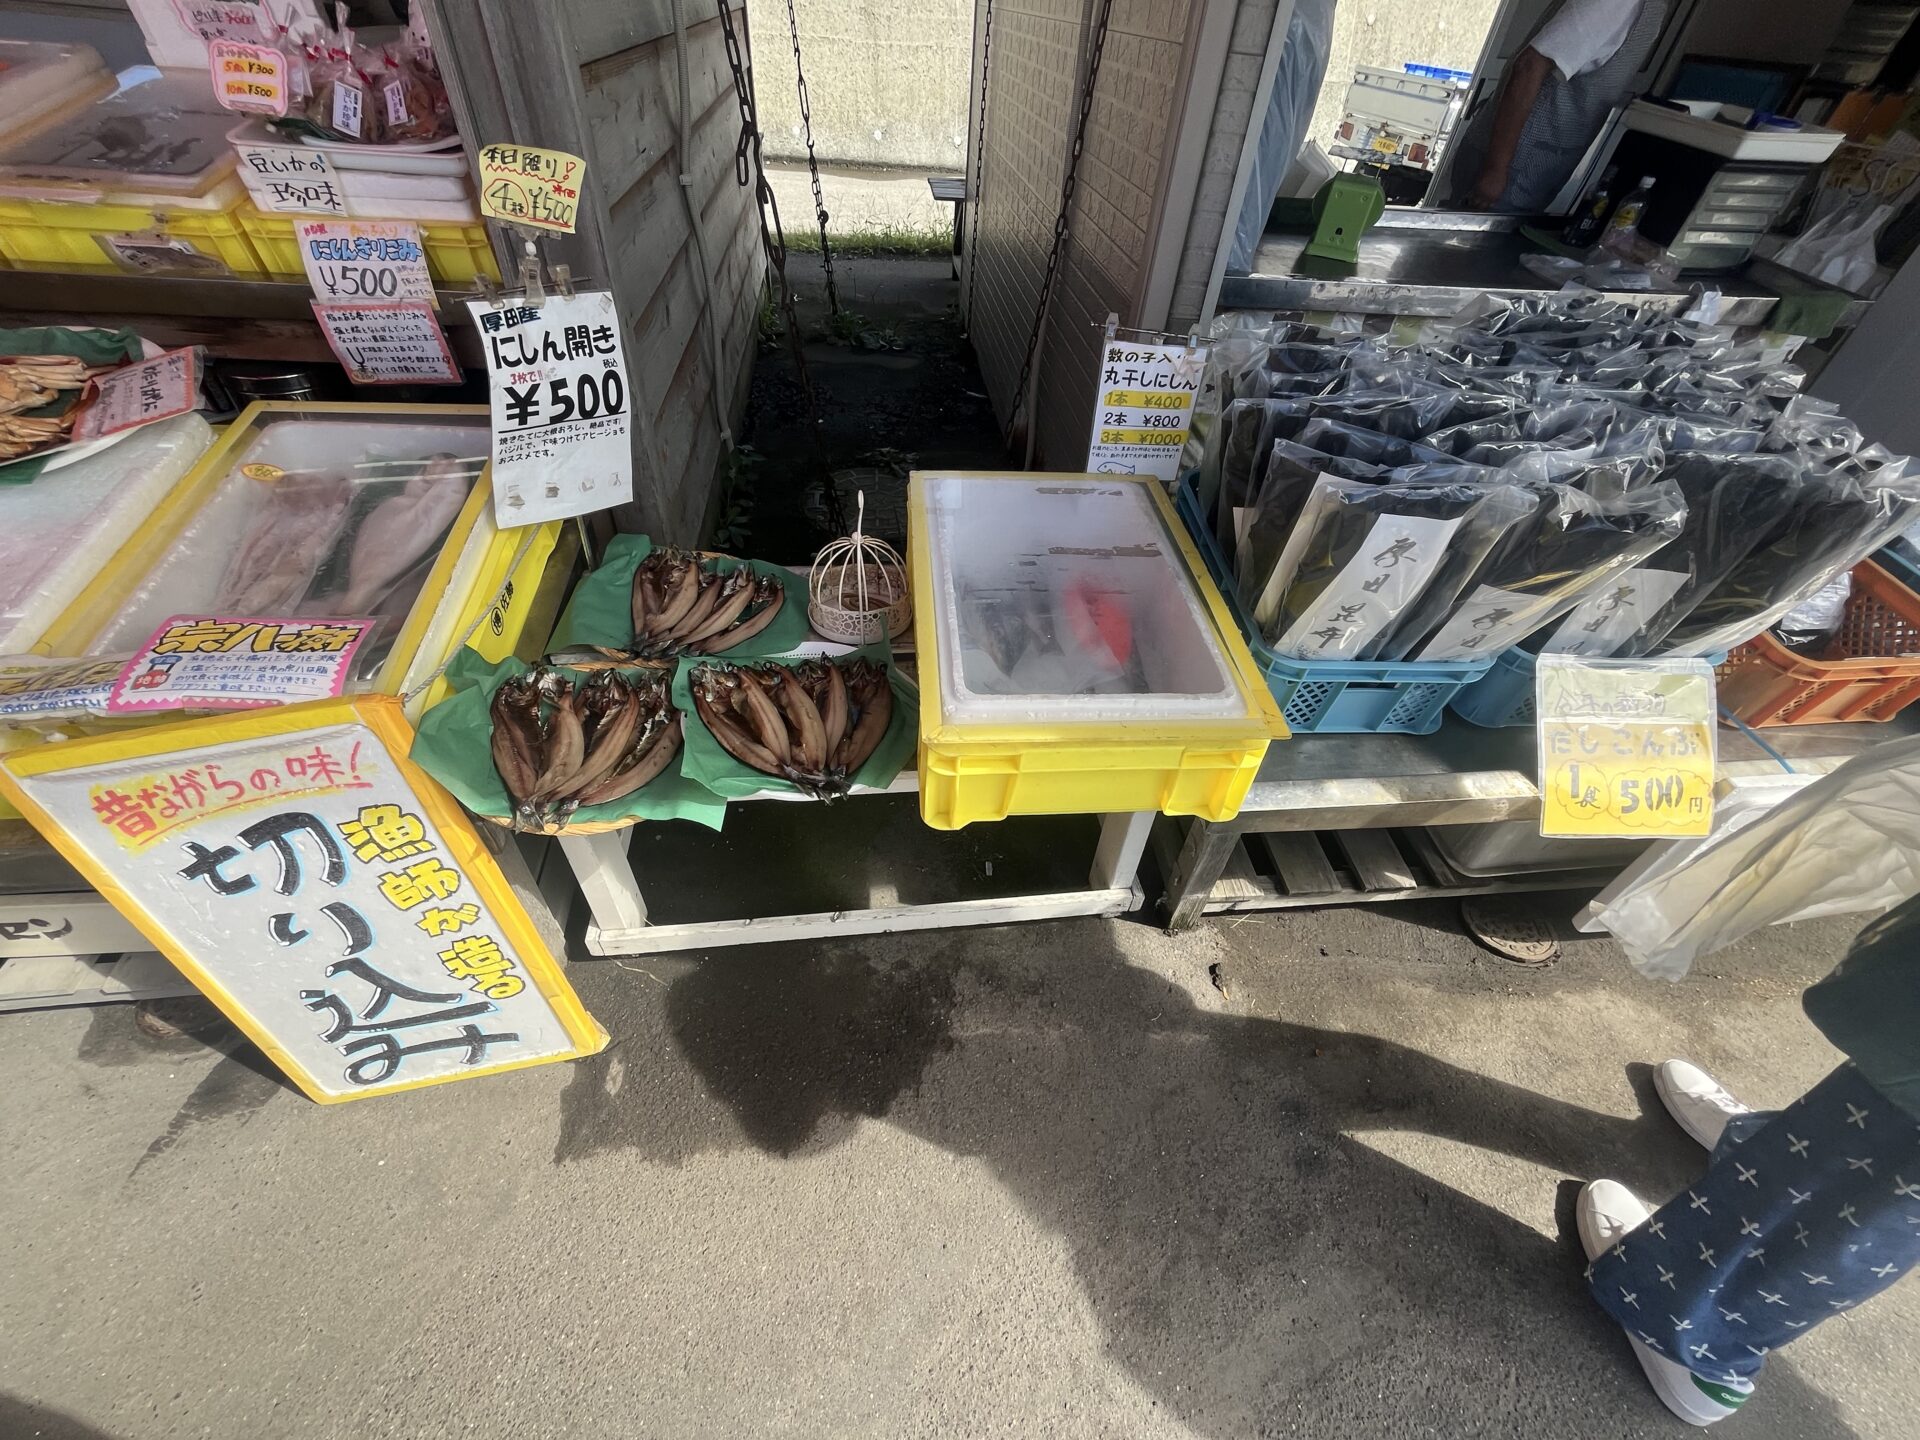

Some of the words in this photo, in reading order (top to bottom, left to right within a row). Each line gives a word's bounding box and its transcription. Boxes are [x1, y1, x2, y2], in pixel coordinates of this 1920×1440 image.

[248, 62, 274, 75] ¥300
[248, 85, 273, 97] ¥500
[247, 153, 326, 174] 豆いかの
[266, 181, 342, 210] 珍味
[528, 187, 573, 224] ¥500
[310, 237, 422, 263] にしんきりこみ
[319, 265, 398, 297] ¥500
[479, 305, 542, 334] 厚田産
[491, 325, 617, 369] にしん開き
[602, 357, 618, 369] 税込
[1104, 367, 1198, 391] 丸干しにしん
[503, 369, 624, 426] ¥500
[1106, 392, 1128, 405] 1本
[1144, 396, 1182, 408] ¥400
[1104, 412, 1127, 425] 2本
[1143, 415, 1180, 427] ¥800
[1100, 432, 1124, 443] 3本
[1139, 433, 1182, 445] ¥1000
[498, 449, 554, 465] おススメです。
[1549, 726, 1699, 756] だしこんぶ
[91, 741, 363, 840] 昔ながらの味!
[1568, 764, 1601, 810] 1袋
[1620, 774, 1703, 814] 500円
[337, 803, 527, 999] 漁師が造る
[177, 811, 521, 1086] 切り込み
